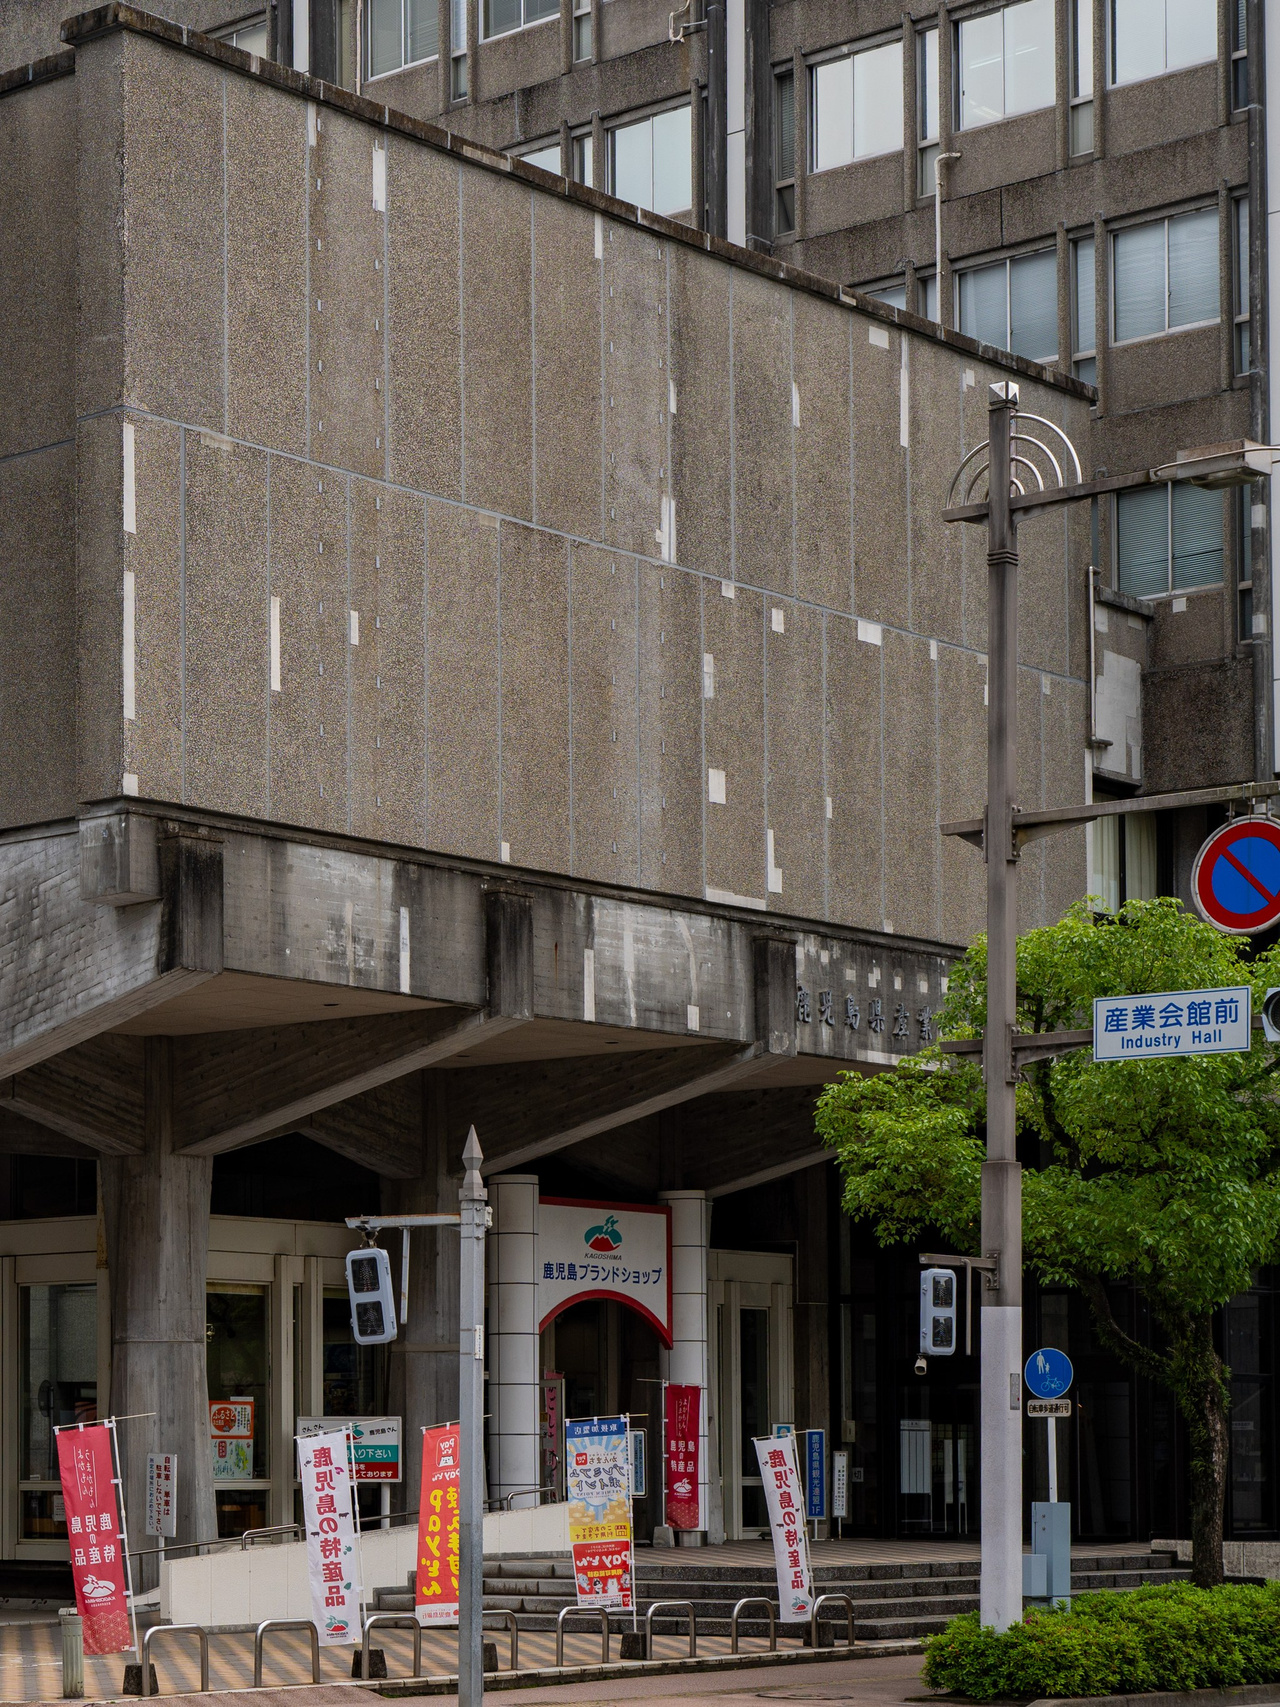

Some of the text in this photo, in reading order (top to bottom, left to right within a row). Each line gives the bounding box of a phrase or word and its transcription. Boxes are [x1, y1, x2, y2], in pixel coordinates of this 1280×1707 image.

[1104, 998, 1239, 1033] 産業会館前
[1121, 1029, 1222, 1049] Industry Hall
[584, 1252, 622, 1260] KAGOSHIMA
[543, 1261, 662, 1285] 鹿児島ブランドショップ
[670, 1440, 695, 1452] 鹿児島
